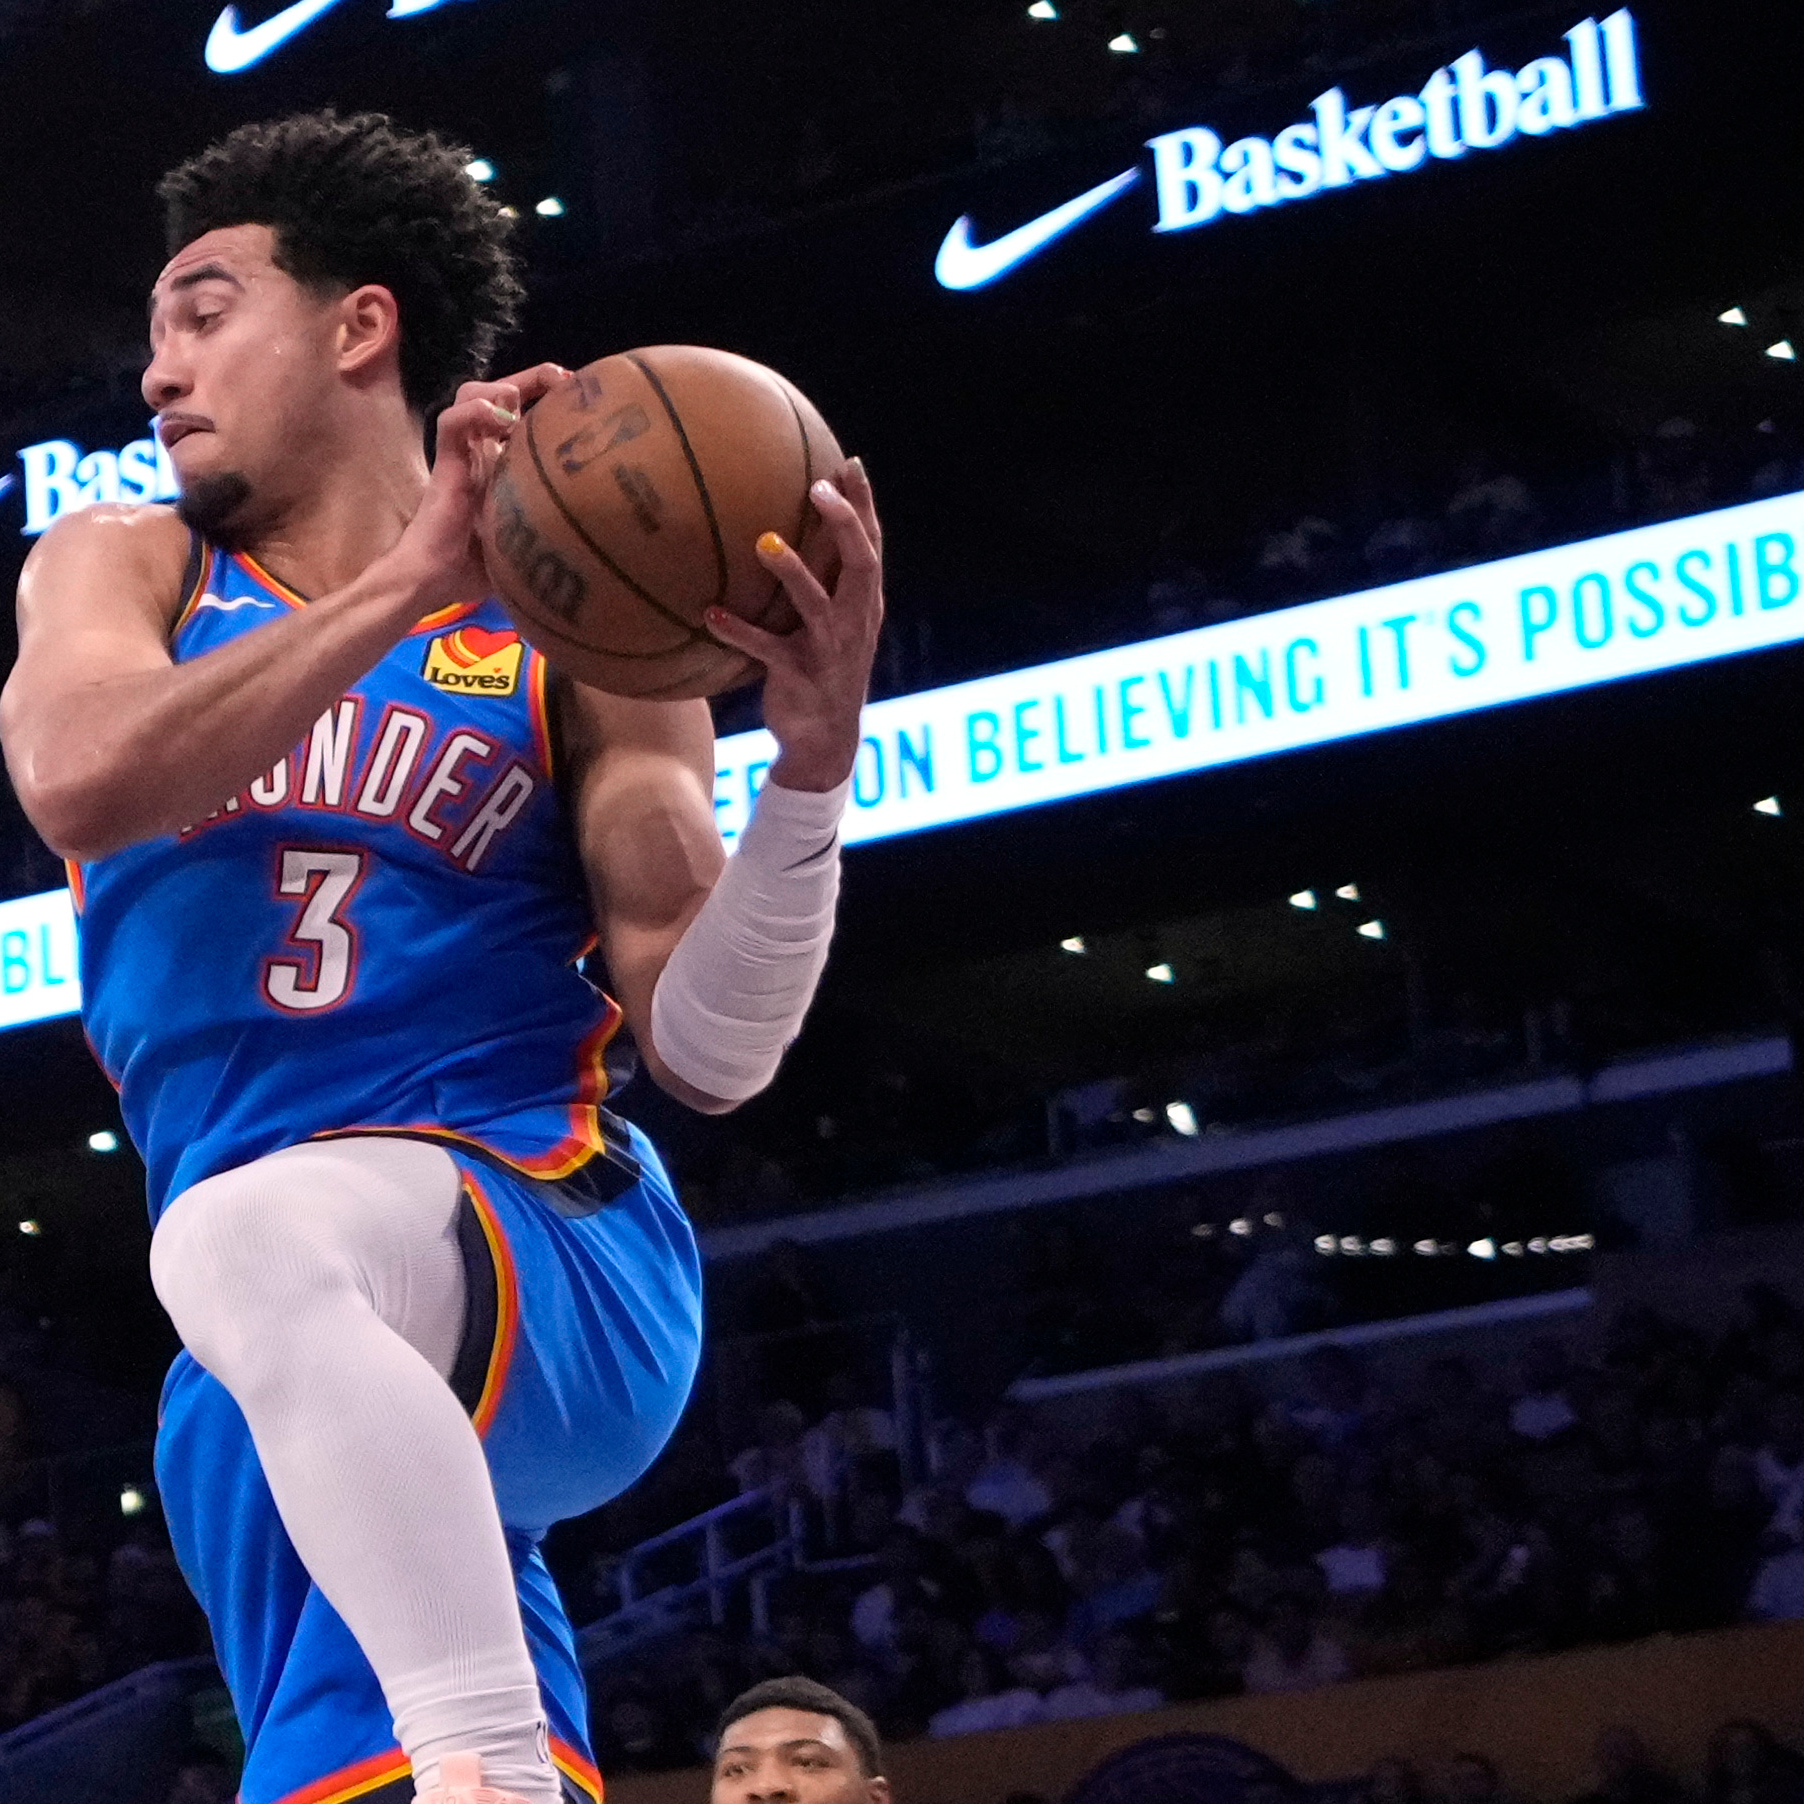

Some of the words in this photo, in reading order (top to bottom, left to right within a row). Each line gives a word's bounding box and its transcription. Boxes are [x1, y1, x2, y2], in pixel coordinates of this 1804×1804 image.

[1147, 9, 1644, 233] Basketball
[854, 723, 935, 808] ON
[966, 638, 1327, 784] BELIEVING
[1358, 601, 1486, 698] IT'S
[1520, 532, 1804, 661] POSSIB
[267, 850, 363, 1008] 3
